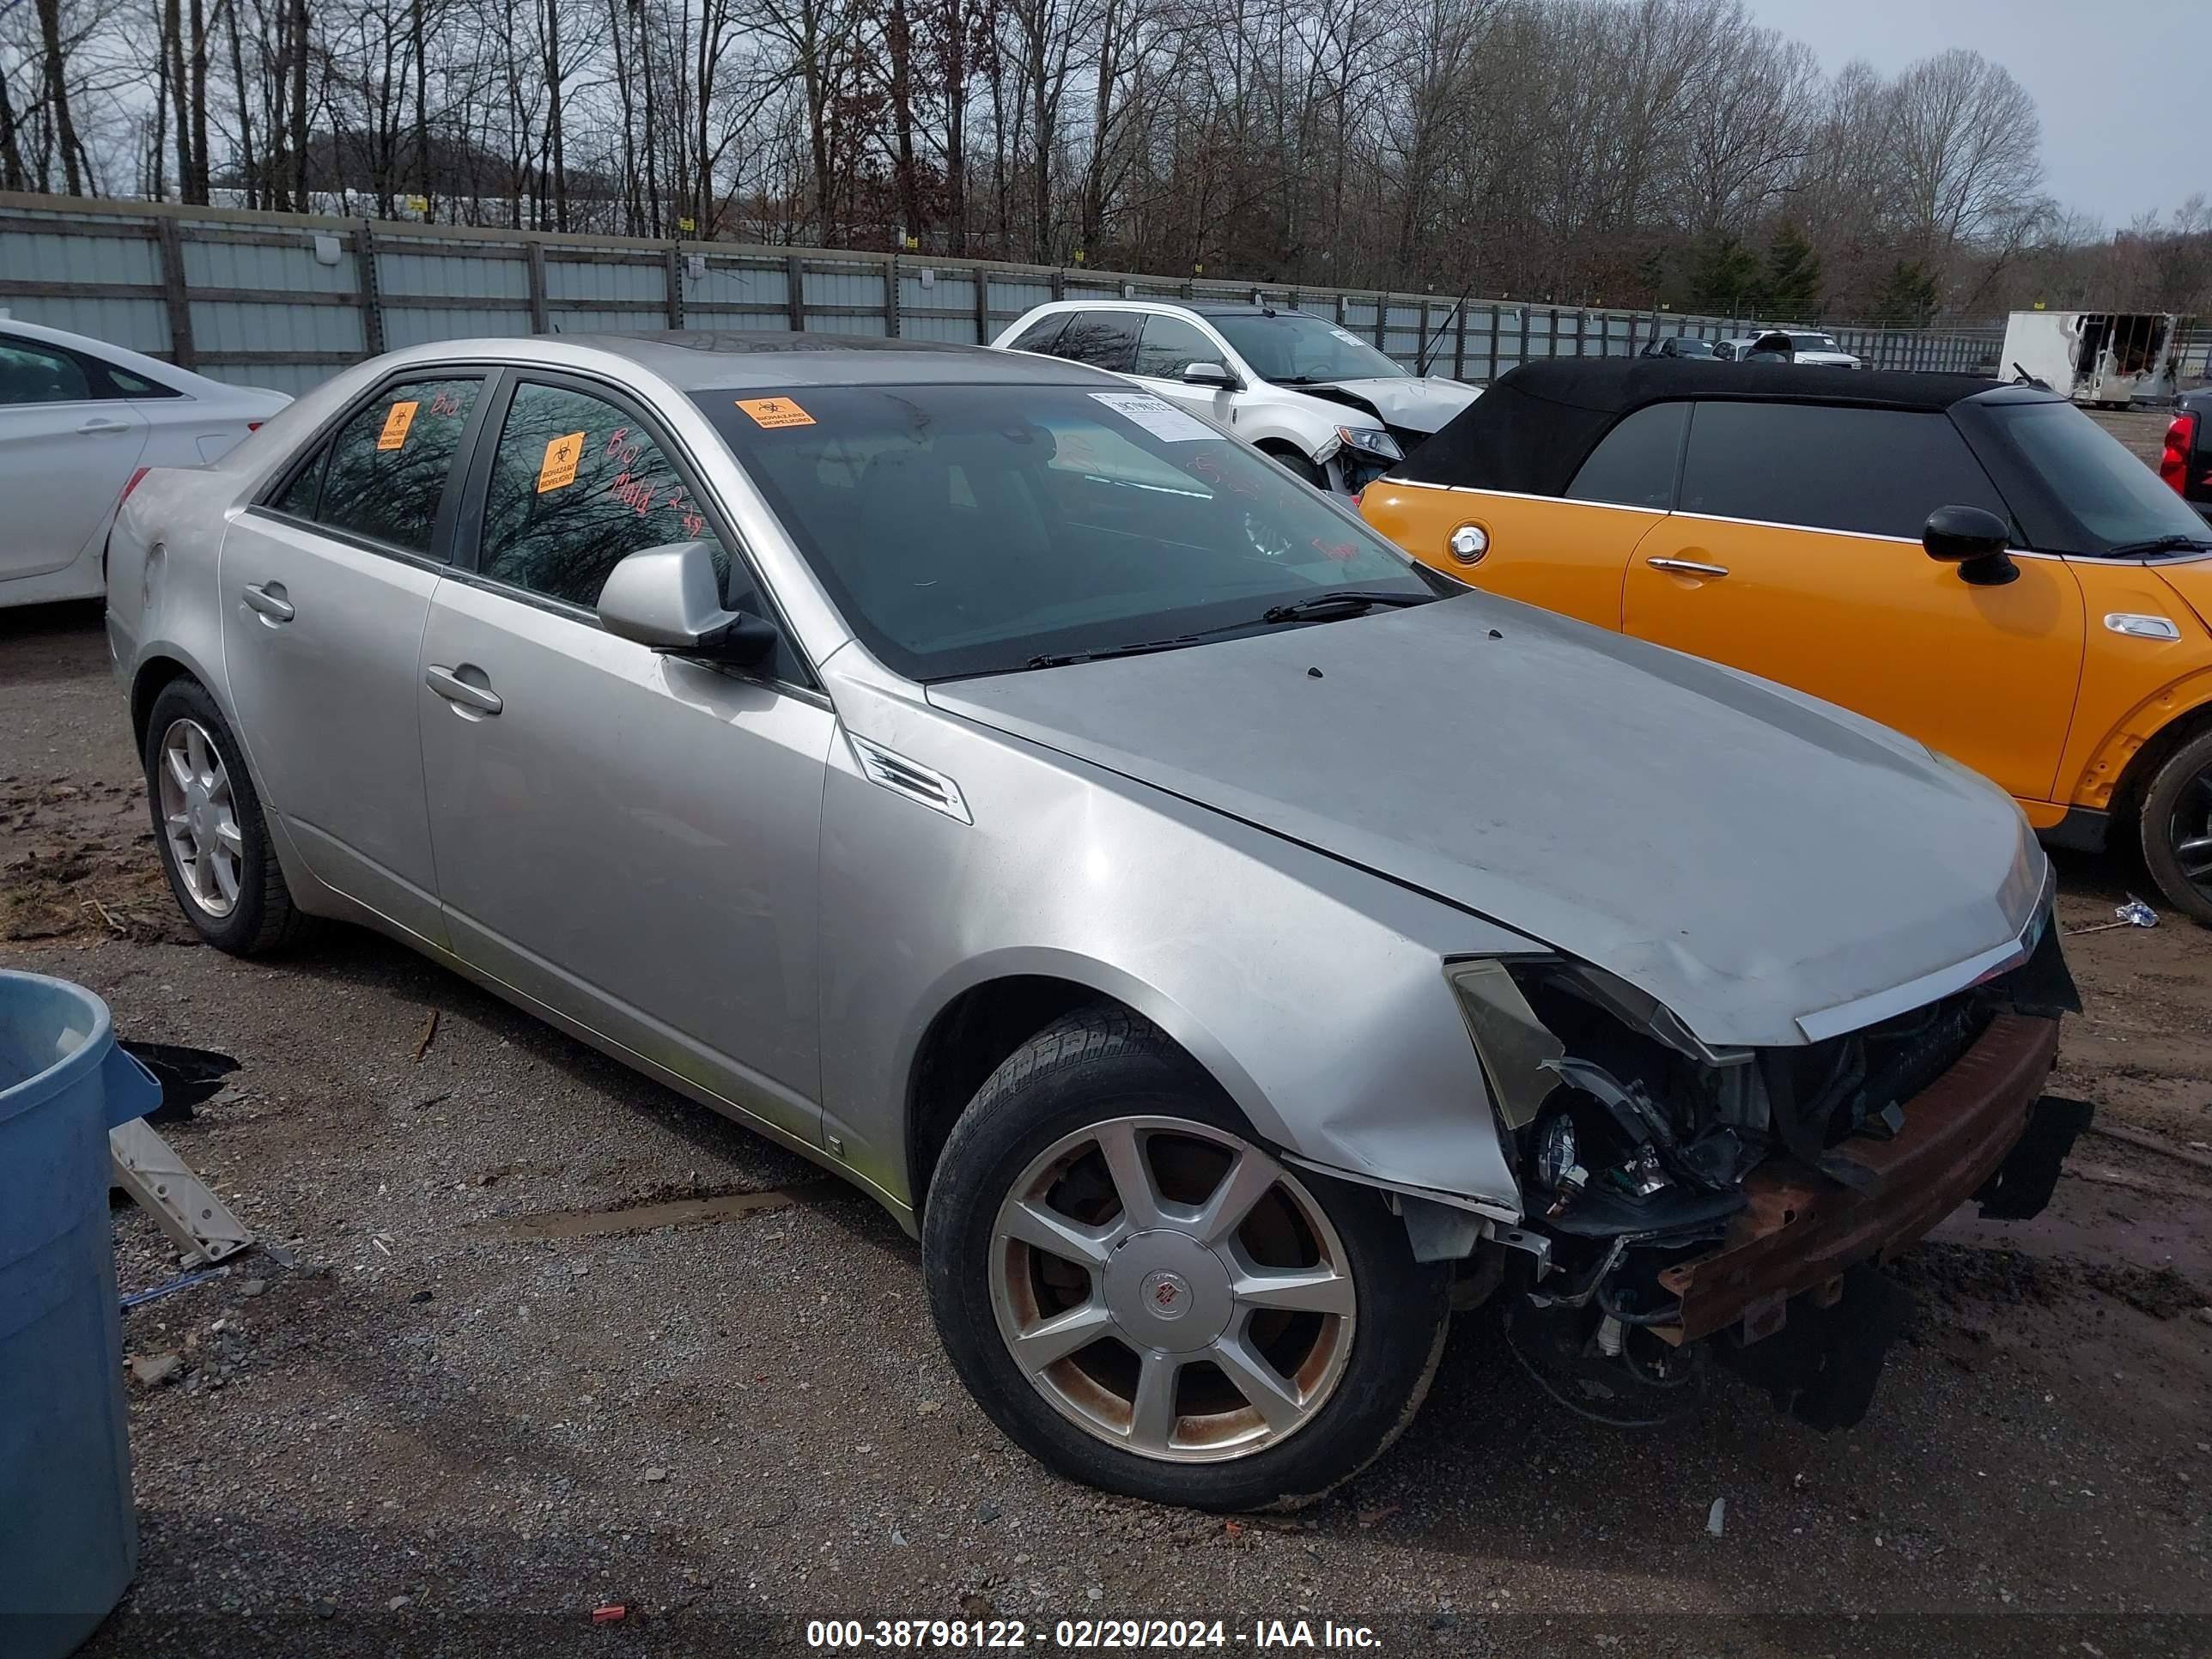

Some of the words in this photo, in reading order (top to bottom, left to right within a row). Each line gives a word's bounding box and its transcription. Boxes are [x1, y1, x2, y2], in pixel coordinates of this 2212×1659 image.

[756, 412, 805, 421] BIOHAZARD
[761, 417, 811, 426] BIOPELIGRO
[542, 464, 575, 479] BIOHAZARD
[540, 473, 573, 489] BIOPELIGRO
